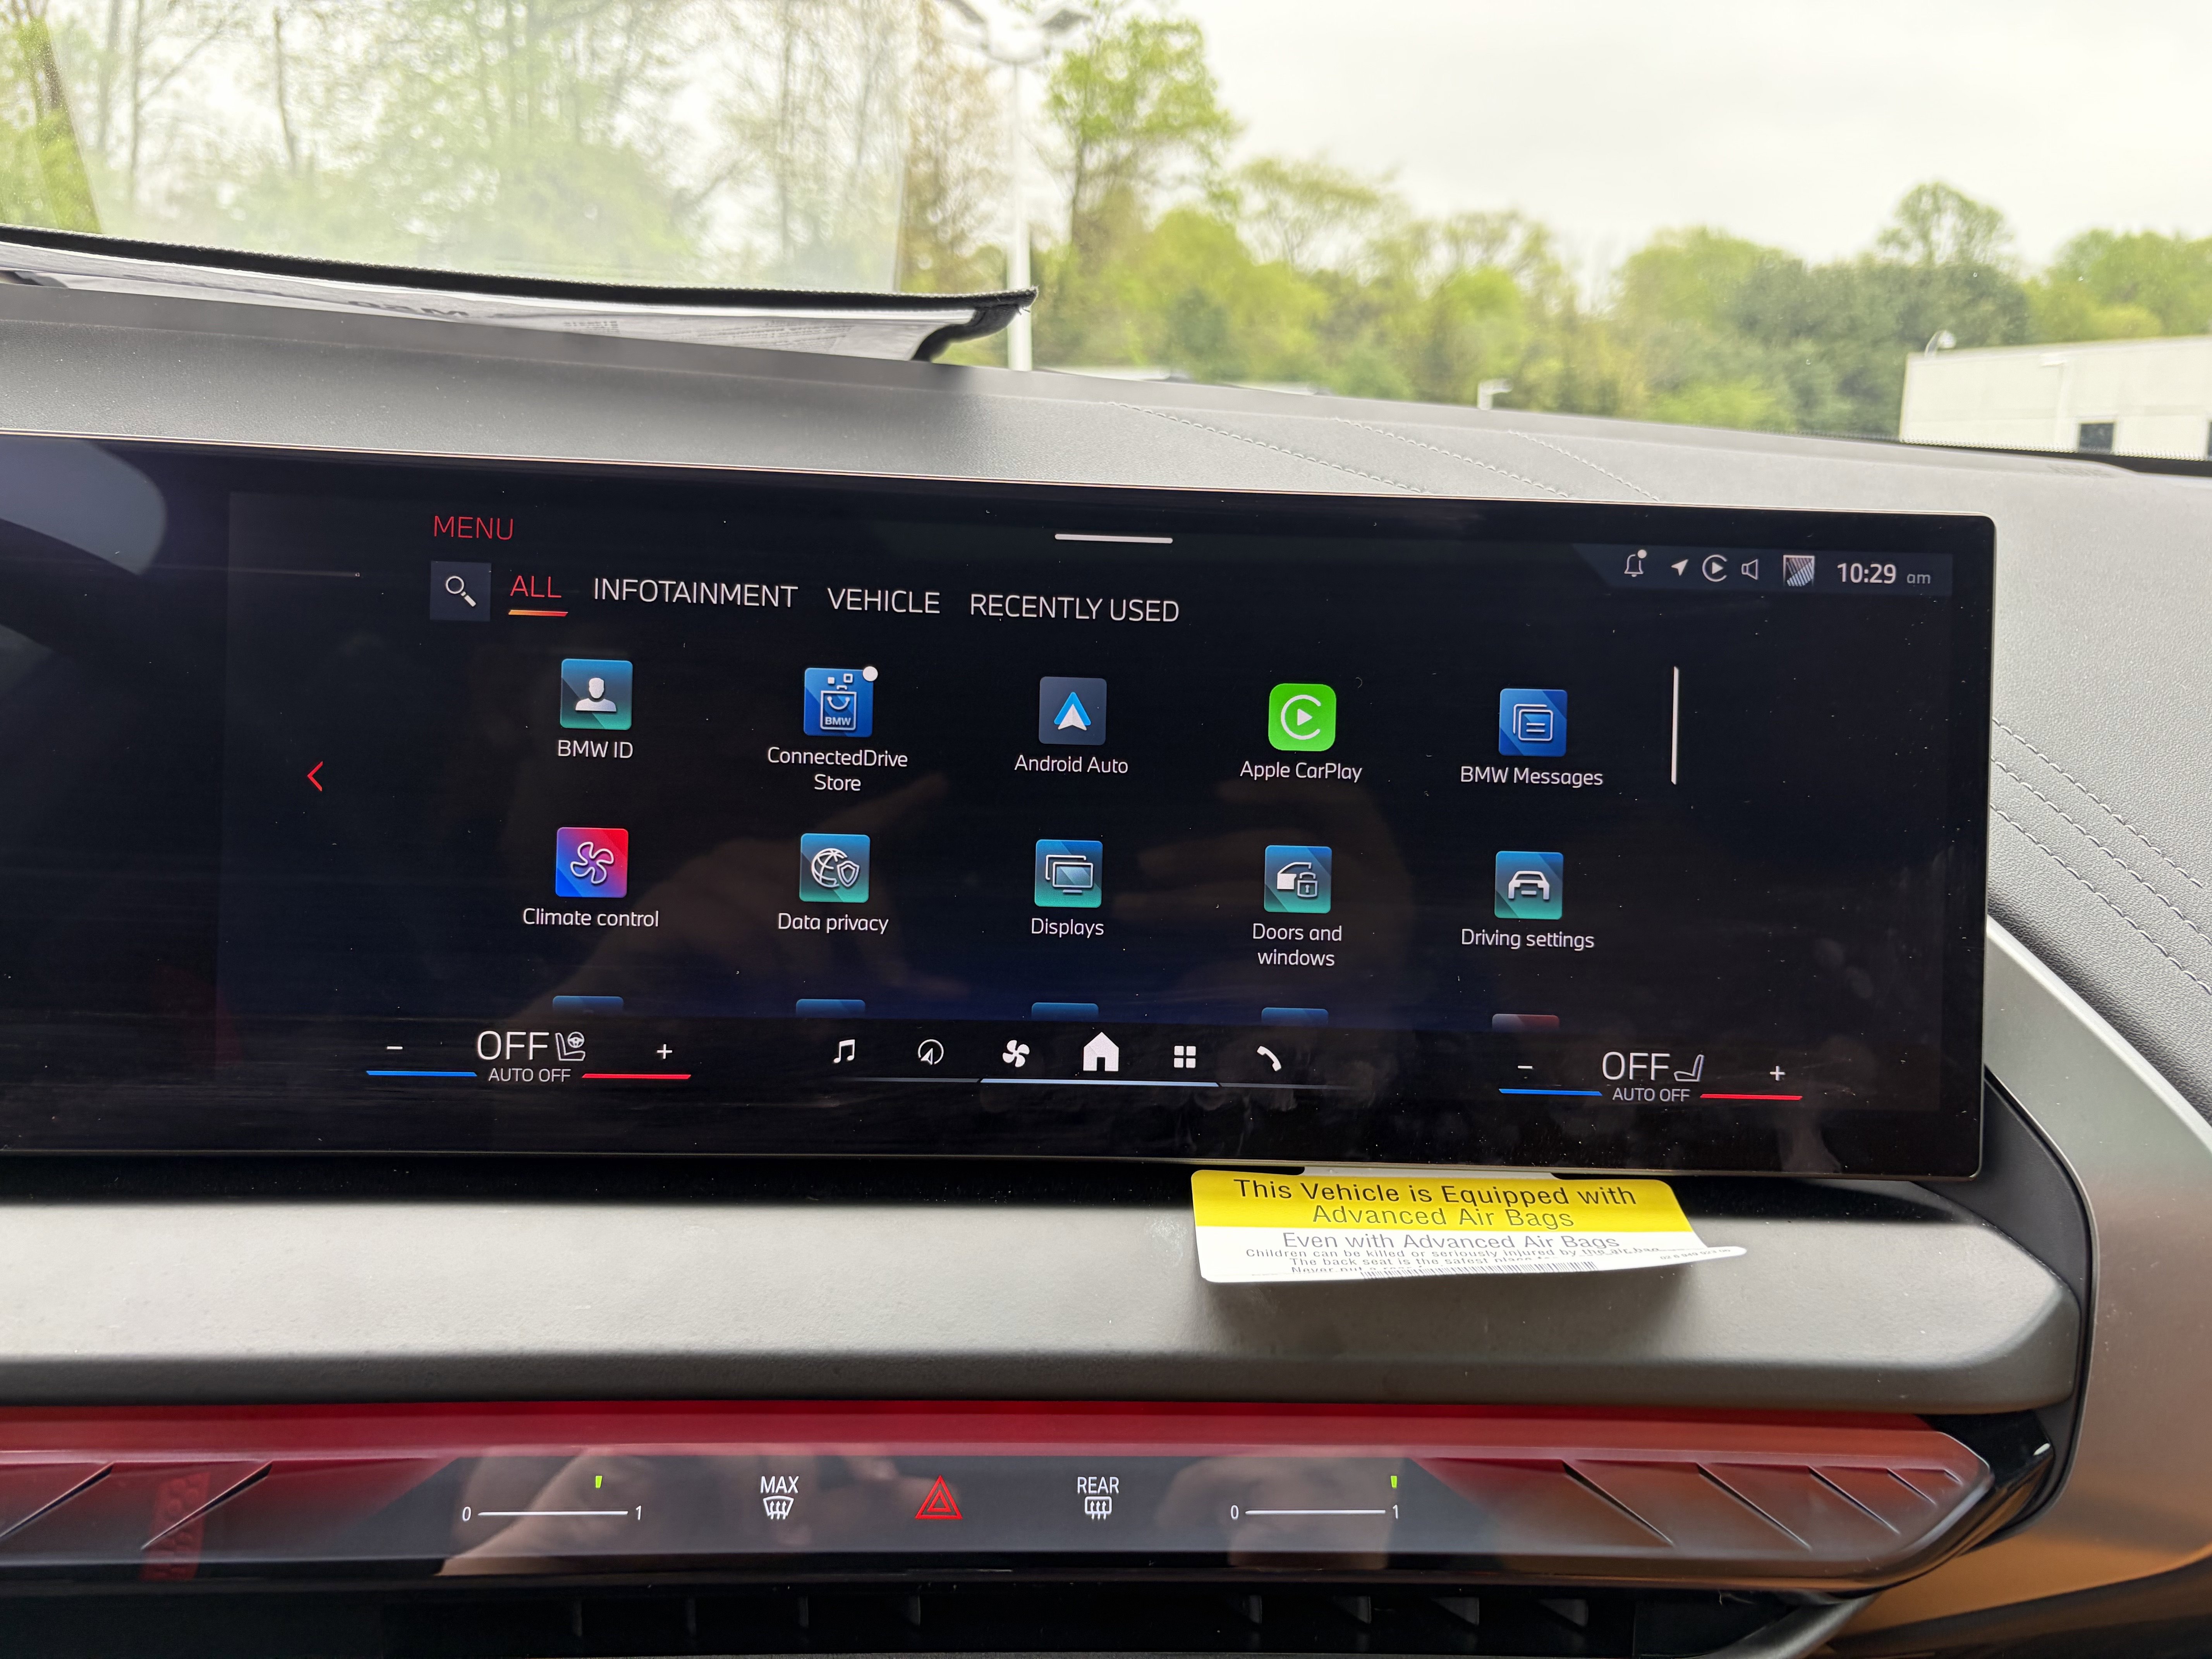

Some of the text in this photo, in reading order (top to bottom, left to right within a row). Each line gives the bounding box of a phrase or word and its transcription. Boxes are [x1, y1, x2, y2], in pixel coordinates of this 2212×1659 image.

[434, 516, 513, 540] MENU
[1838, 563, 1930, 584] 10:29 am
[510, 575, 561, 598] ALL
[595, 578, 798, 607] INFOTAINMENT
[828, 588, 939, 613] VEHICLE
[971, 594, 1178, 622] RECENTLY USED
[825, 717, 851, 725] BMW
[558, 740, 633, 758] BMW ID
[768, 747, 907, 766] ConnectedDrive
[1015, 755, 1128, 773] Android Auto
[1240, 761, 1362, 783] Apple CarPlay
[815, 774, 861, 791] Store
[1461, 766, 1603, 788] BMW Messages
[523, 908, 658, 926] Climate control
[779, 913, 888, 934] Data privacy
[1032, 918, 1104, 938] Displays
[1253, 923, 1341, 941] Doors and
[1462, 929, 1594, 951] Driving settings
[1258, 949, 1334, 966] windows
[477, 1031, 549, 1060] OFF
[489, 1068, 571, 1082] AUTO OFF
[1602, 1052, 1670, 1080] OFF
[1613, 1088, 1690, 1101] AUTO OFF
[1234, 1179, 1636, 1207] This Vehicle is Equipped with
[1313, 1205, 1573, 1230] Advanced Air Bags
[1283, 1233, 1620, 1250] Even with Advanced Air Bags
[1246, 1249, 1307, 1257] Children
[1559, 1249, 1576, 1257] by
[761, 1476, 799, 1493] MAX
[1078, 1477, 1119, 1494] REAR
[462, 1505, 642, 1521] 0 1
[1231, 1504, 1399, 1519] 0 1
